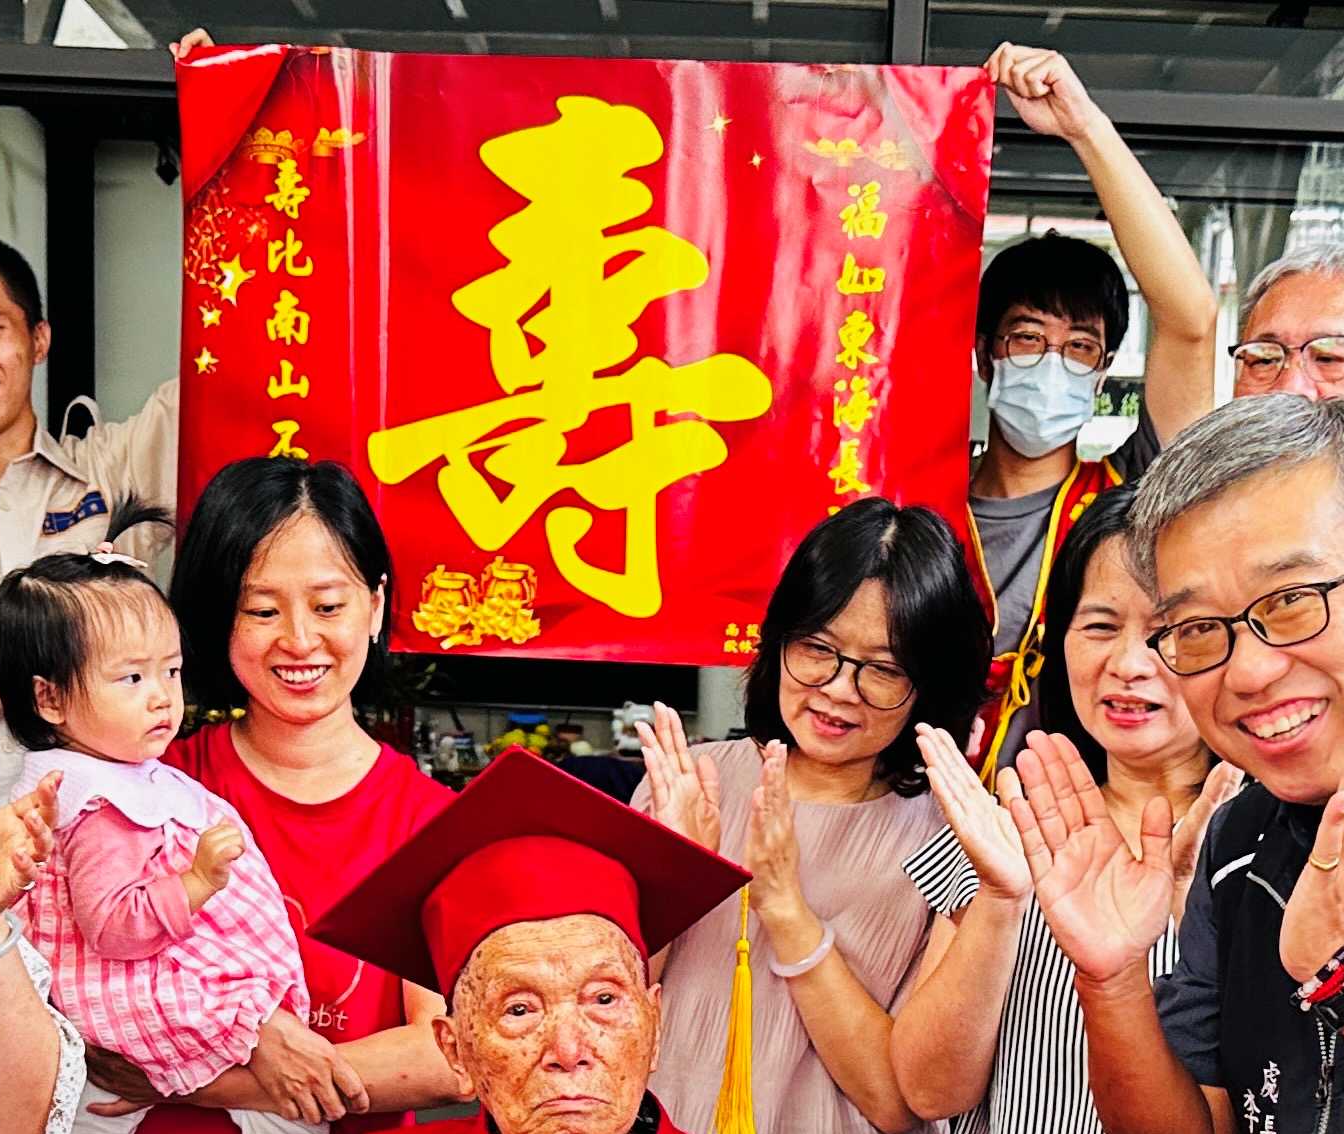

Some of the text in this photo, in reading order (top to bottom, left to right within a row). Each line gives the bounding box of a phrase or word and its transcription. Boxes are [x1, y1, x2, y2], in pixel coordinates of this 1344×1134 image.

[827, 181, 888, 516] 福如東海長
